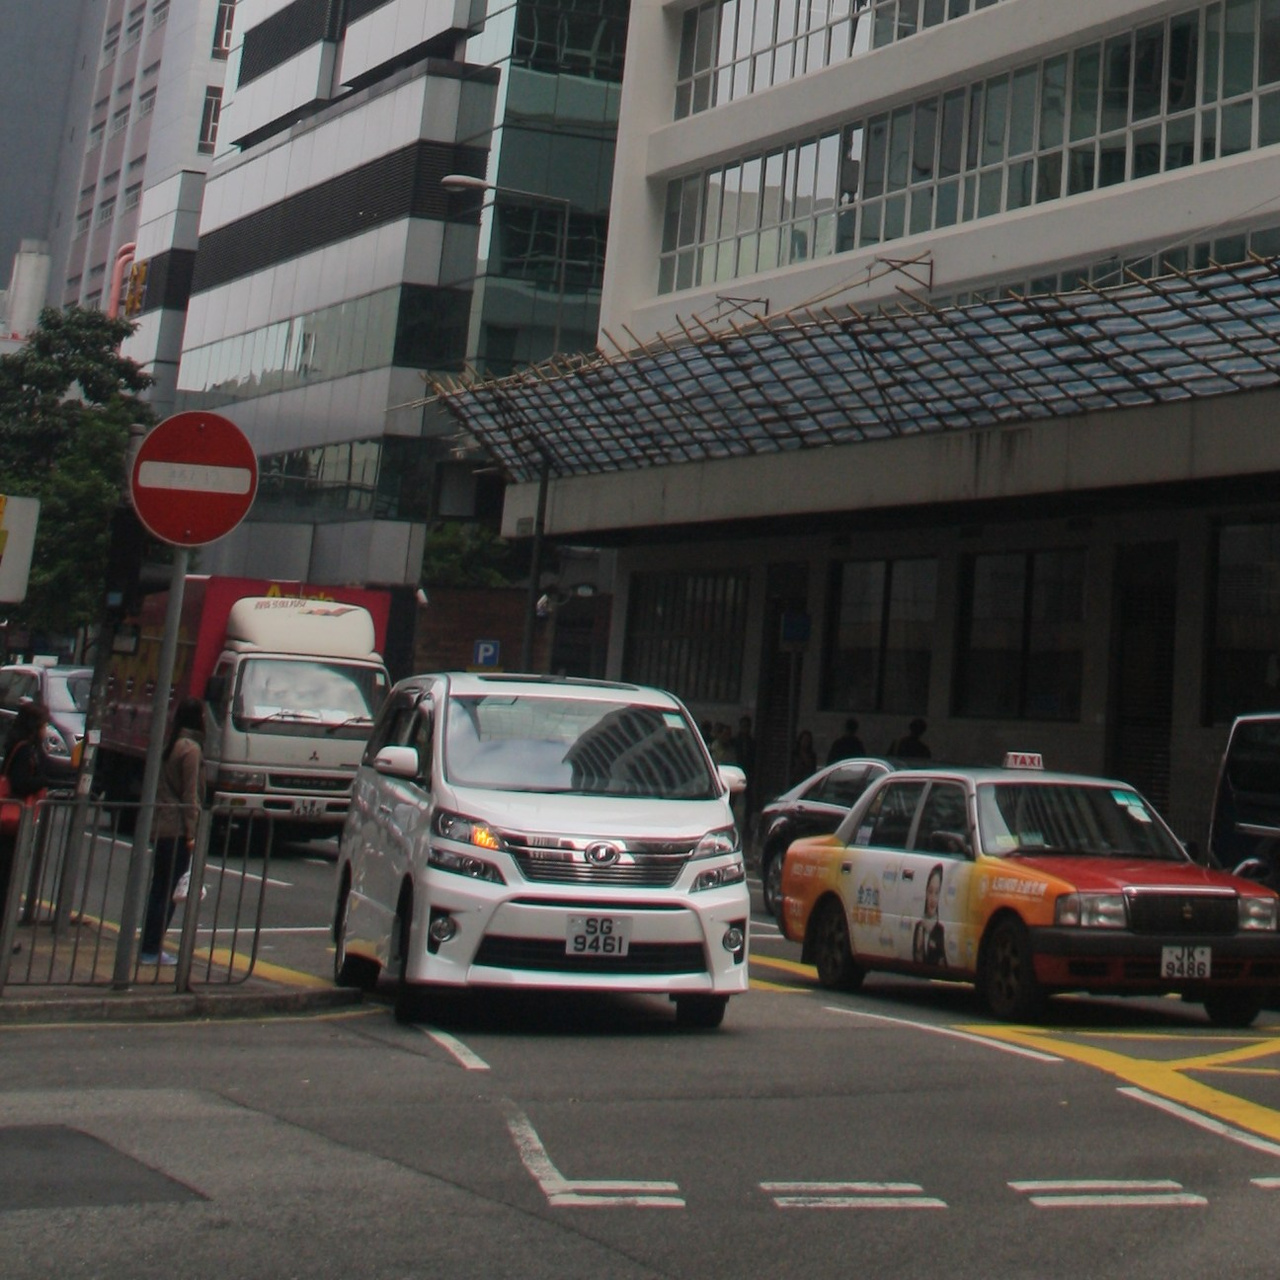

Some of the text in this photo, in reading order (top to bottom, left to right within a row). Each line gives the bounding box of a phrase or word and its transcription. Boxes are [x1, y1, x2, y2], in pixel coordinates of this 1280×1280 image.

[478, 643, 494, 664] P
[1012, 754, 1041, 767] TAXI
[585, 918, 613, 934] SG
[573, 935, 622, 953] 9461
[1175, 946, 1195, 961] JK
[1166, 962, 1206, 977] 9486
